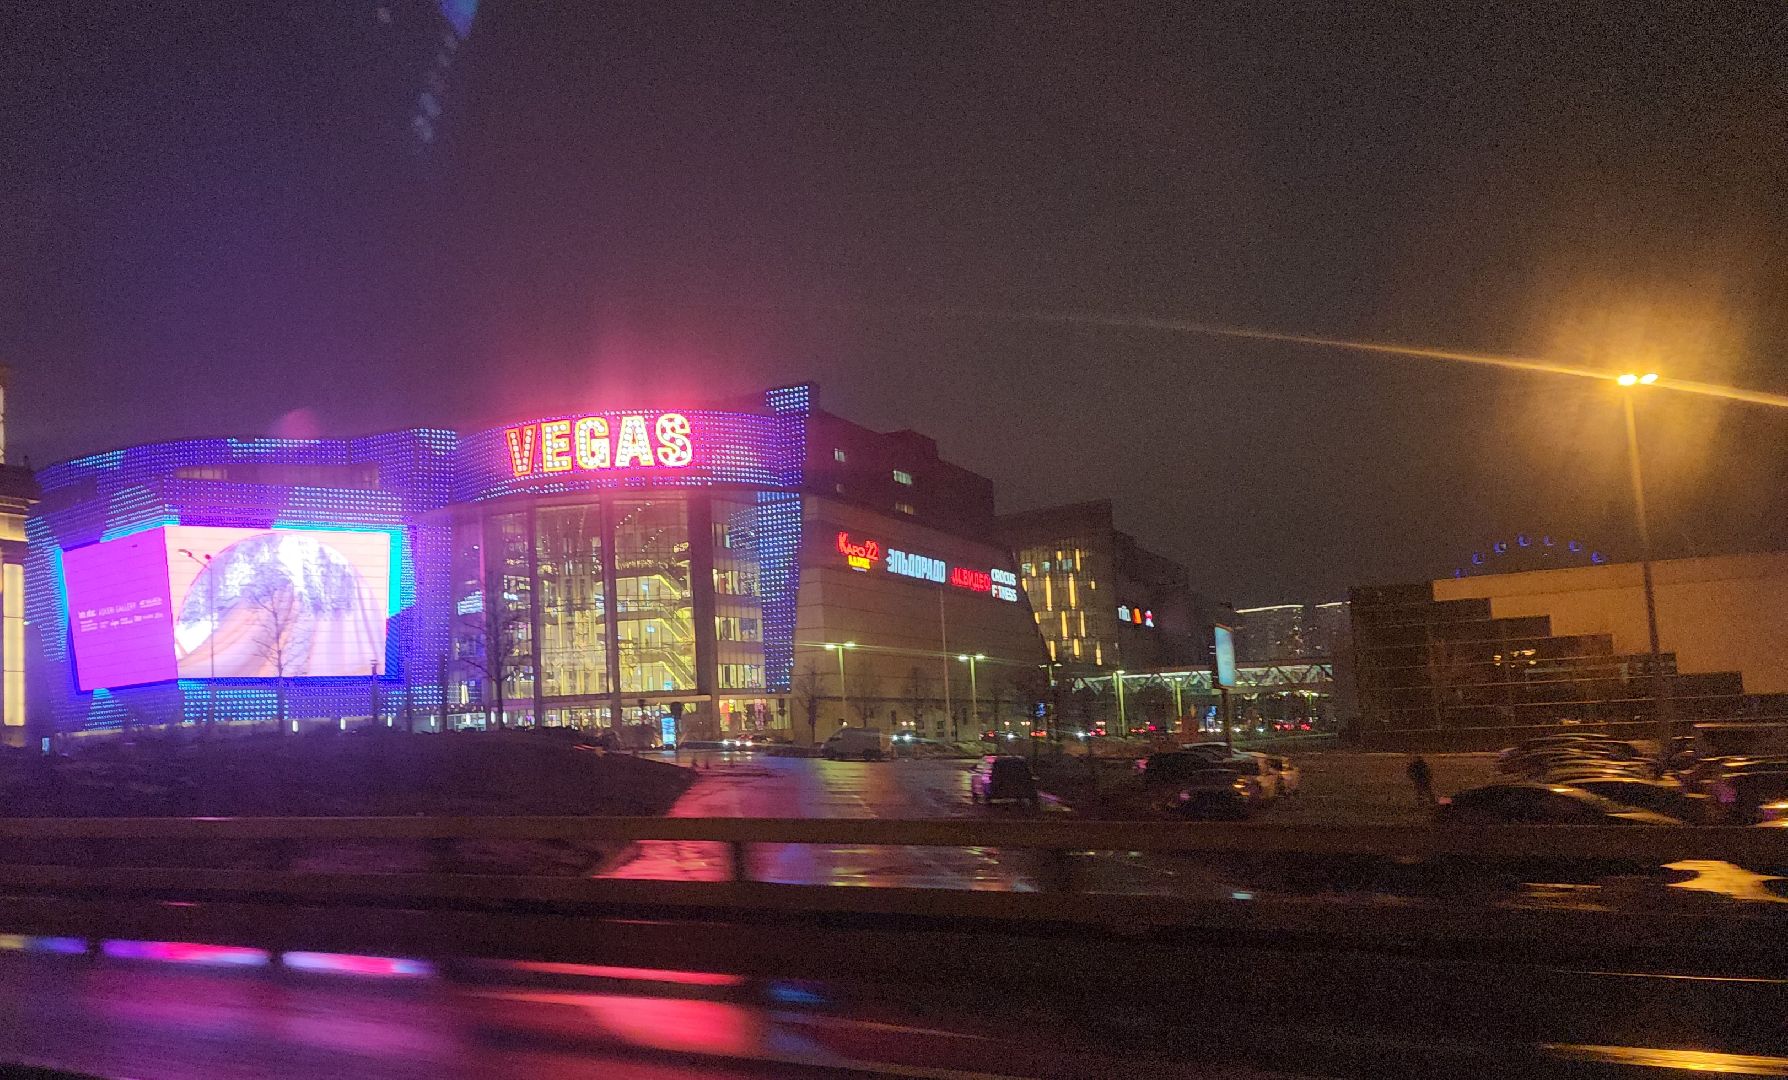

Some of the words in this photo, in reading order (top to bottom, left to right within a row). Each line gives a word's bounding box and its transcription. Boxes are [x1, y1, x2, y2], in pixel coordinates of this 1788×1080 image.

[505, 413, 692, 477] VEGAS
[865, 540, 879, 561] 22
[886, 548, 946, 583] ЭЛЬДОРАДО
[991, 568, 1016, 587] CROCUS
[991, 584, 1018, 602] FITNESS
